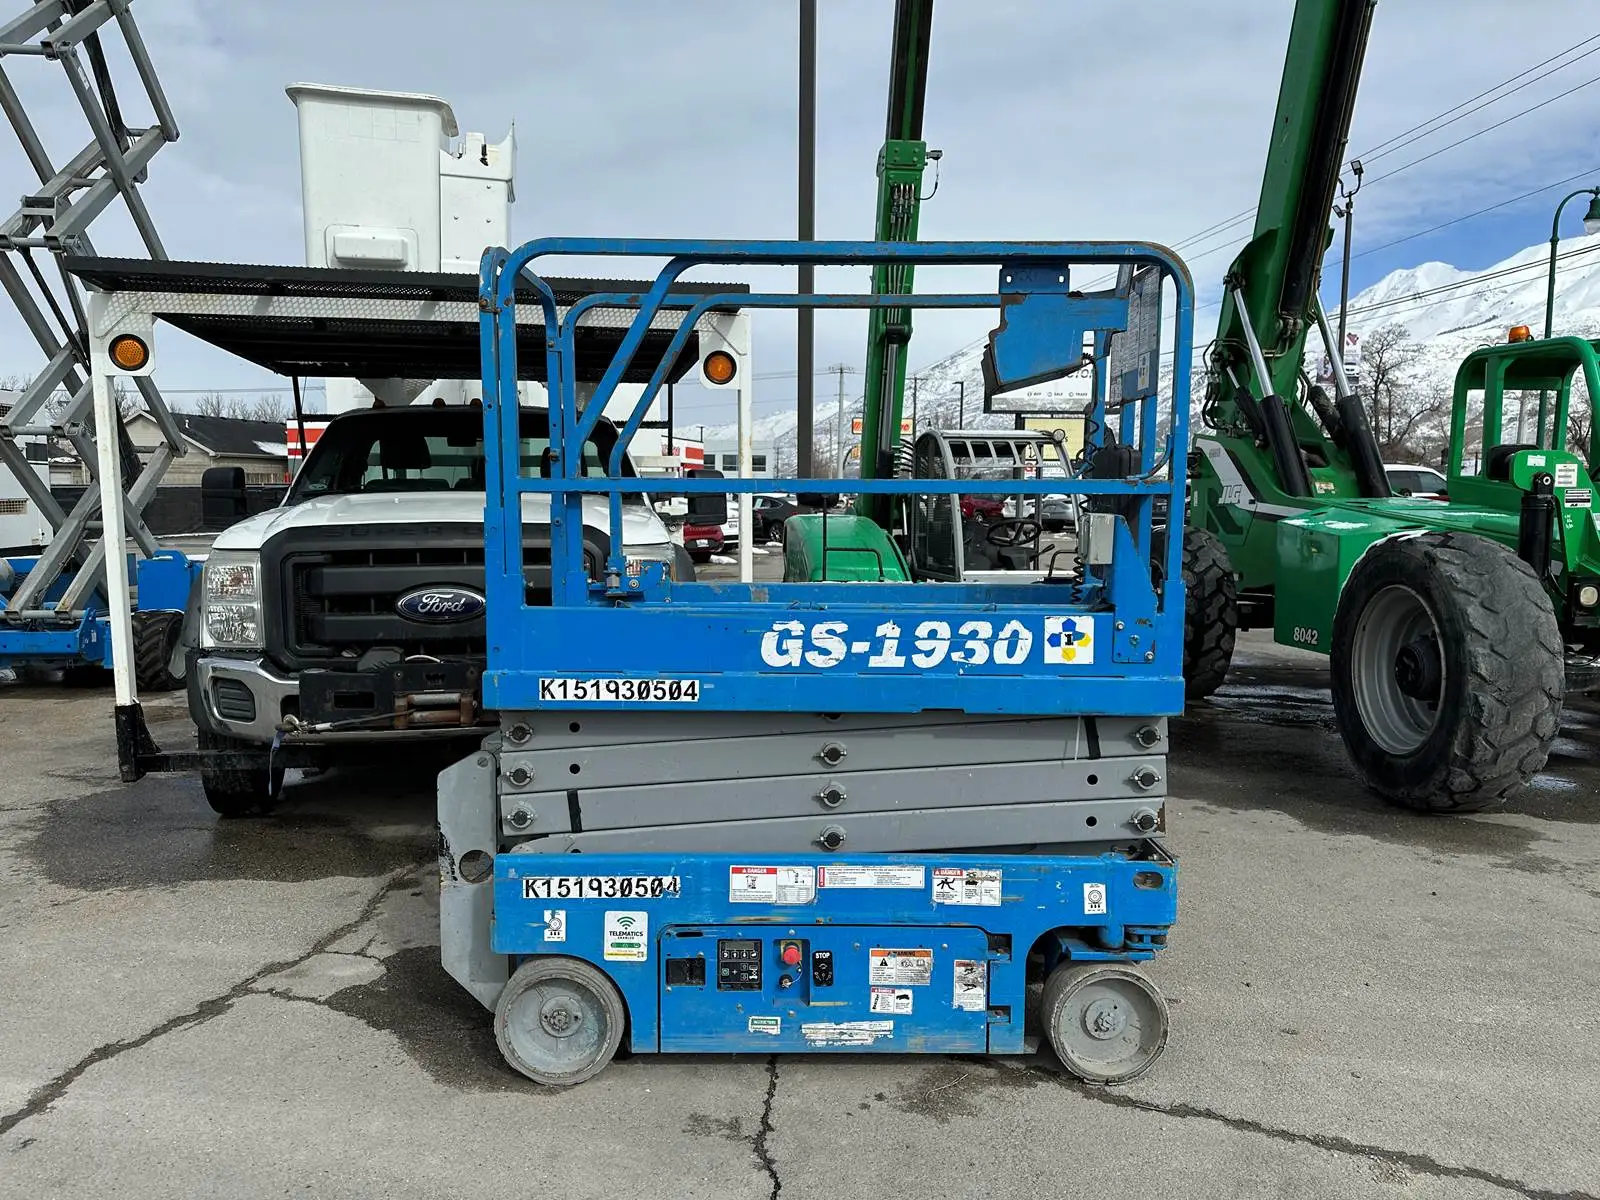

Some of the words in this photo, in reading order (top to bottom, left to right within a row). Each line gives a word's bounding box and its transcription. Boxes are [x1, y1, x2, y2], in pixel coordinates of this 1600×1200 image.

[1218, 484, 1242, 504] JLG
[417, 593, 465, 613] Ford
[760, 619, 1034, 668] GS-1930
[1293, 626, 1318, 645] 8042
[540, 678, 698, 701] K151930504
[815, 952, 831, 960] STOP
